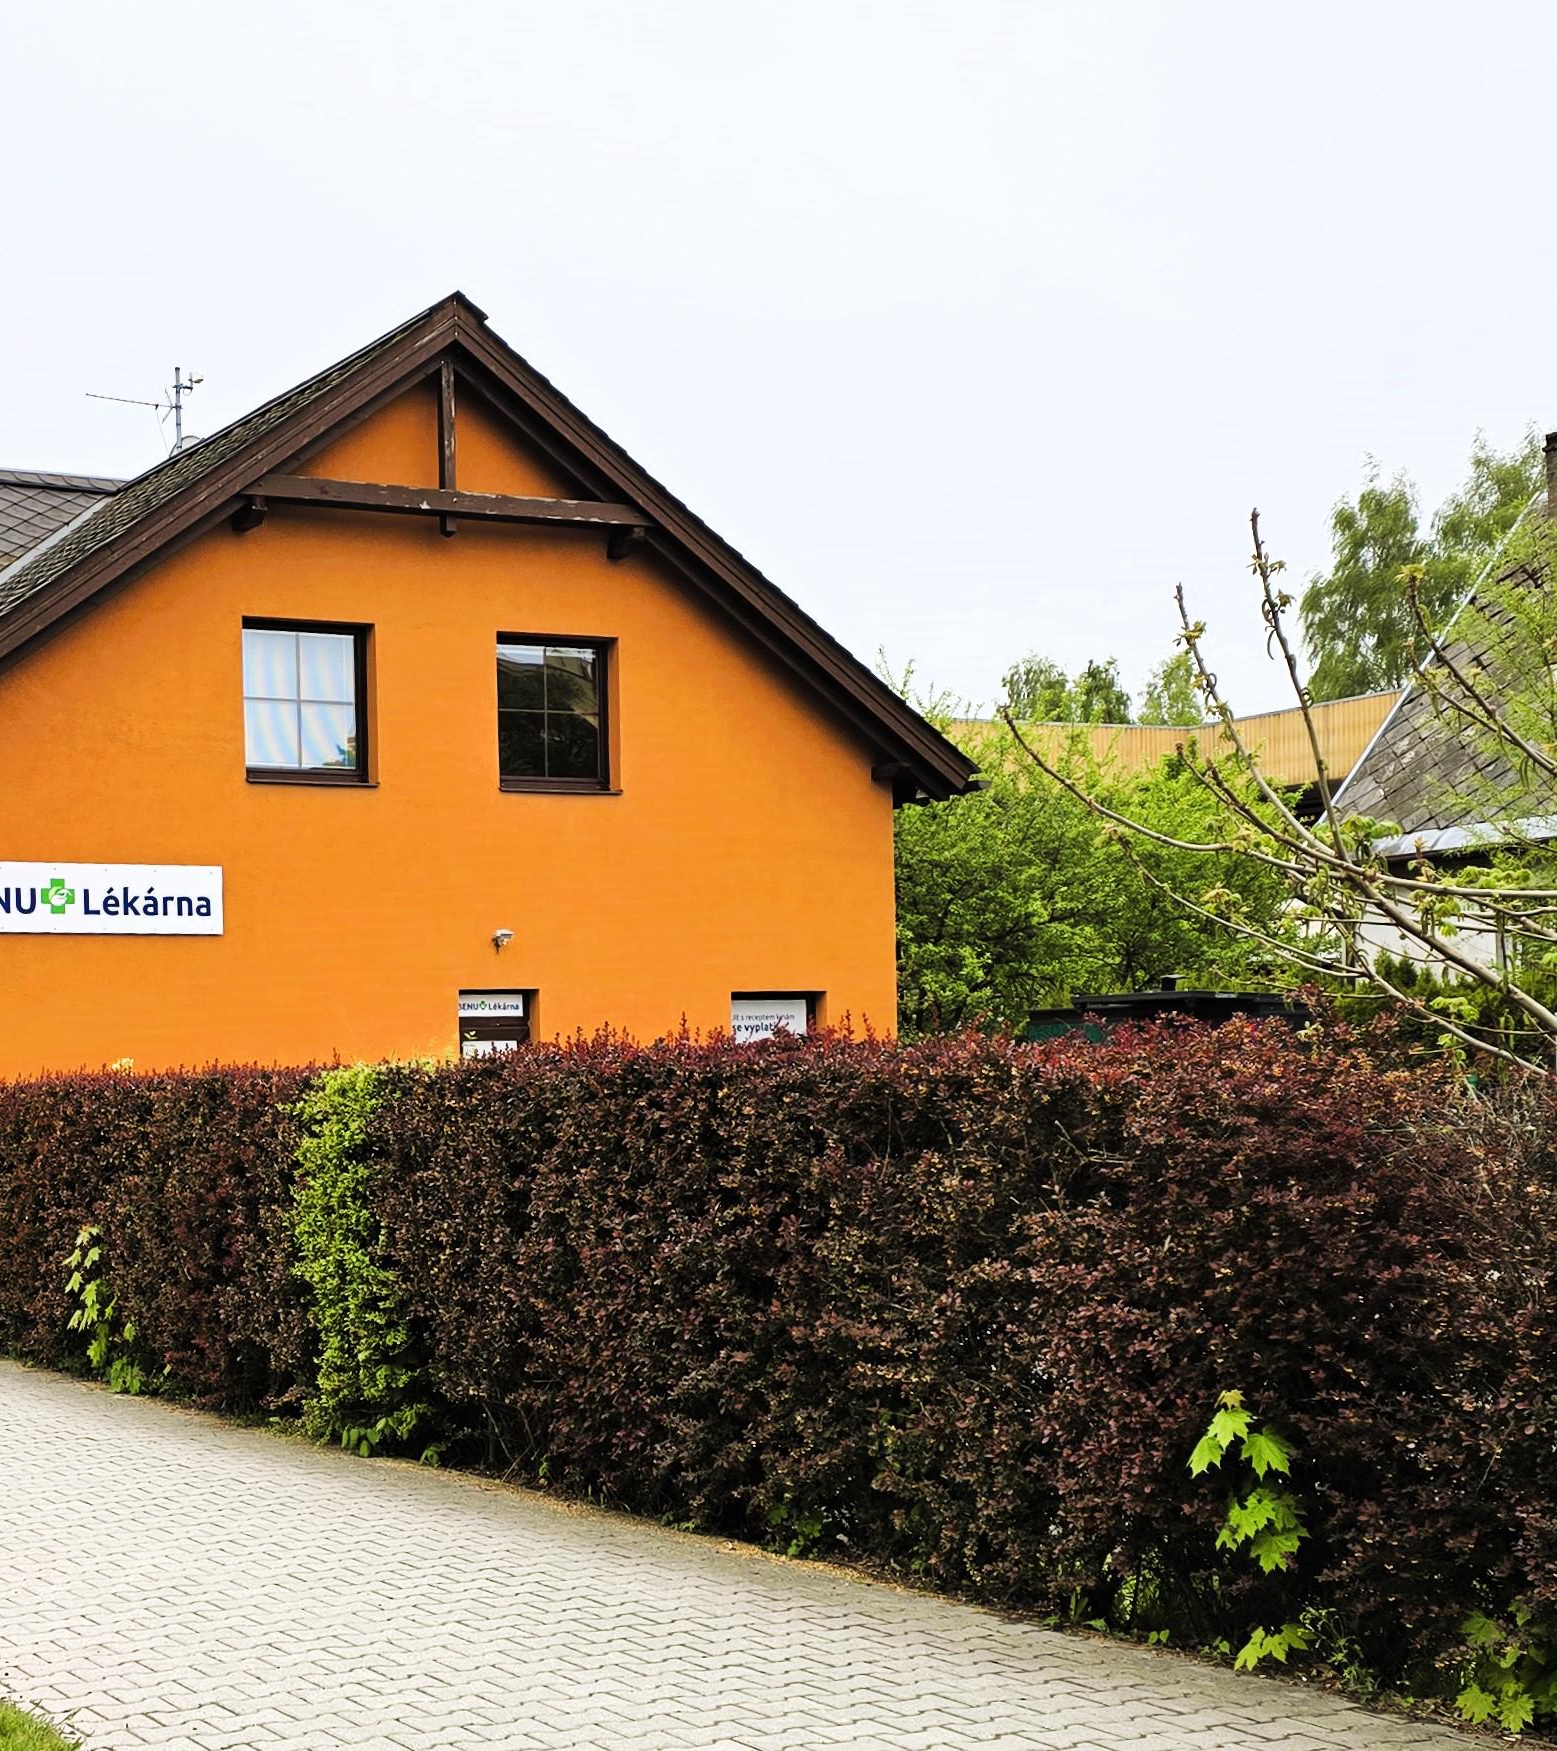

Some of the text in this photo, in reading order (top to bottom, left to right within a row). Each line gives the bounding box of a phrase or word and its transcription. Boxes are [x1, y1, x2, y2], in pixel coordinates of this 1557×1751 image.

[83, 887, 212, 917] Lékárna
[488, 1002, 519, 1011] Lékárna
[745, 1014, 775, 1022] receptem
